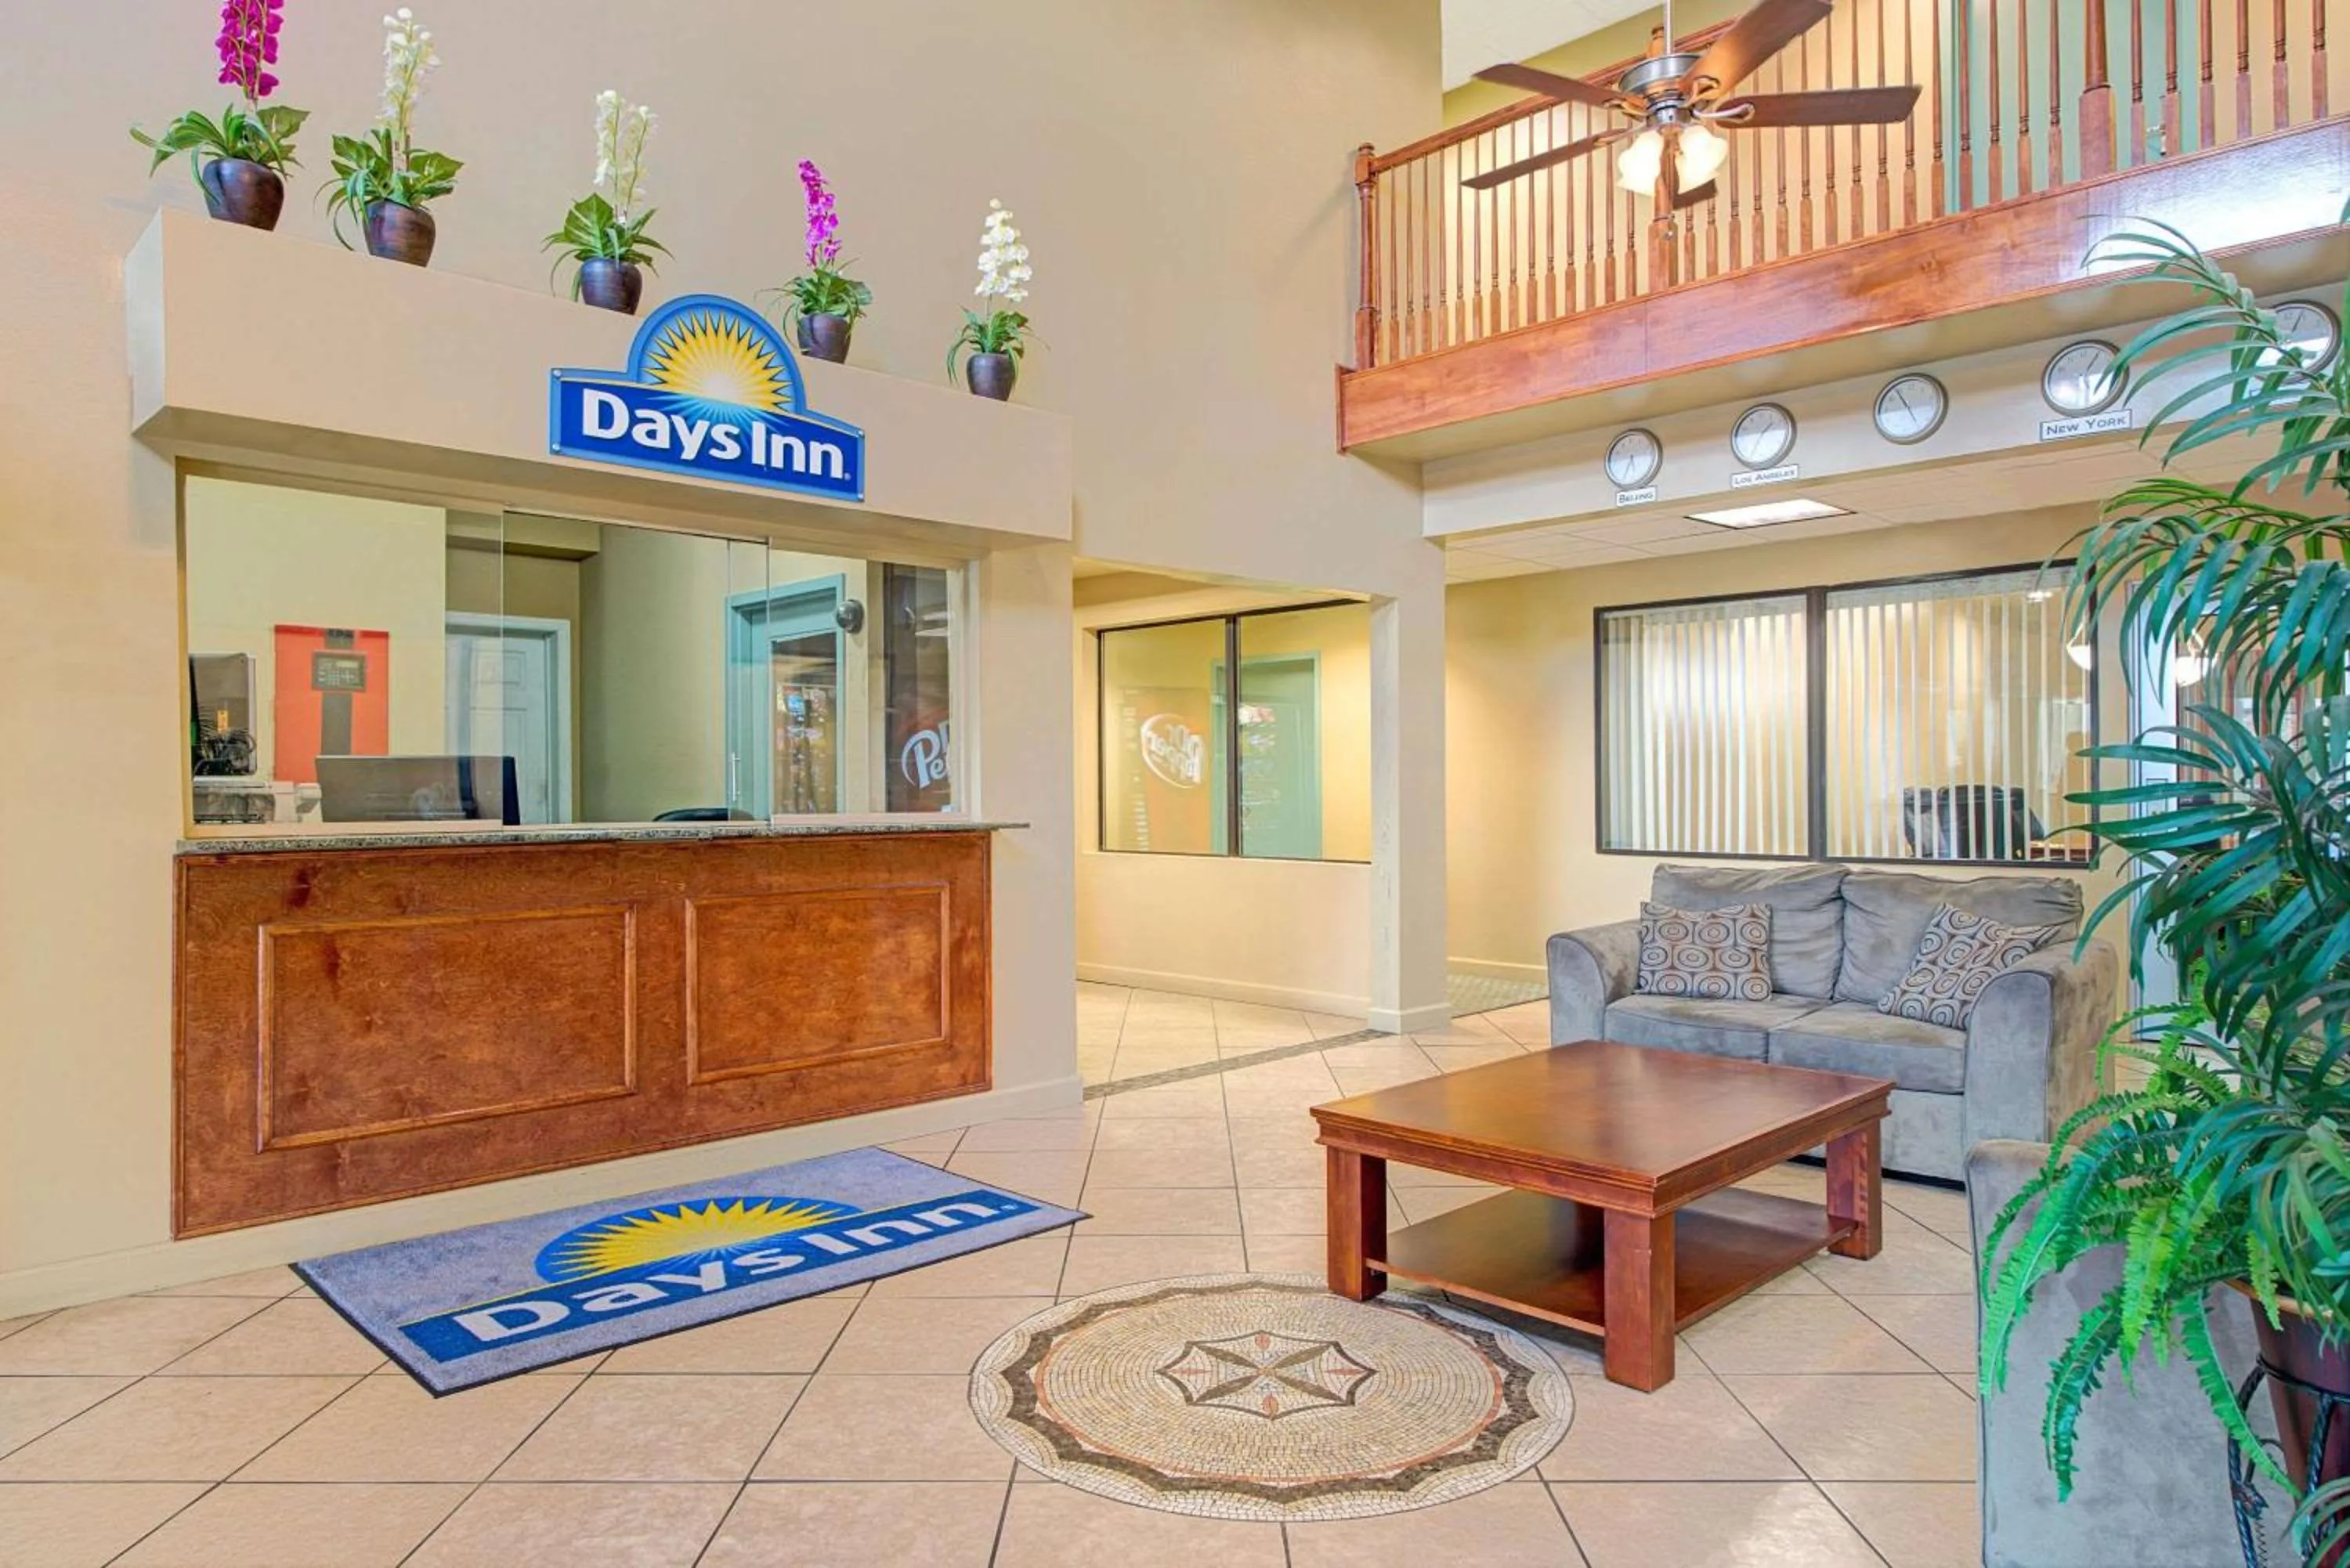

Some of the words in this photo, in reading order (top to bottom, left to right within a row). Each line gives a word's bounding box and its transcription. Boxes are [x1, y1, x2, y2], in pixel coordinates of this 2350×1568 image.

[582, 388, 742, 461] Days
[750, 421, 844, 479] Inn
[2046, 424, 2080, 435] NEW
[2085, 417, 2126, 428] YORK
[453, 1248, 805, 1342] Days
[799, 1202, 1000, 1255] Inn
